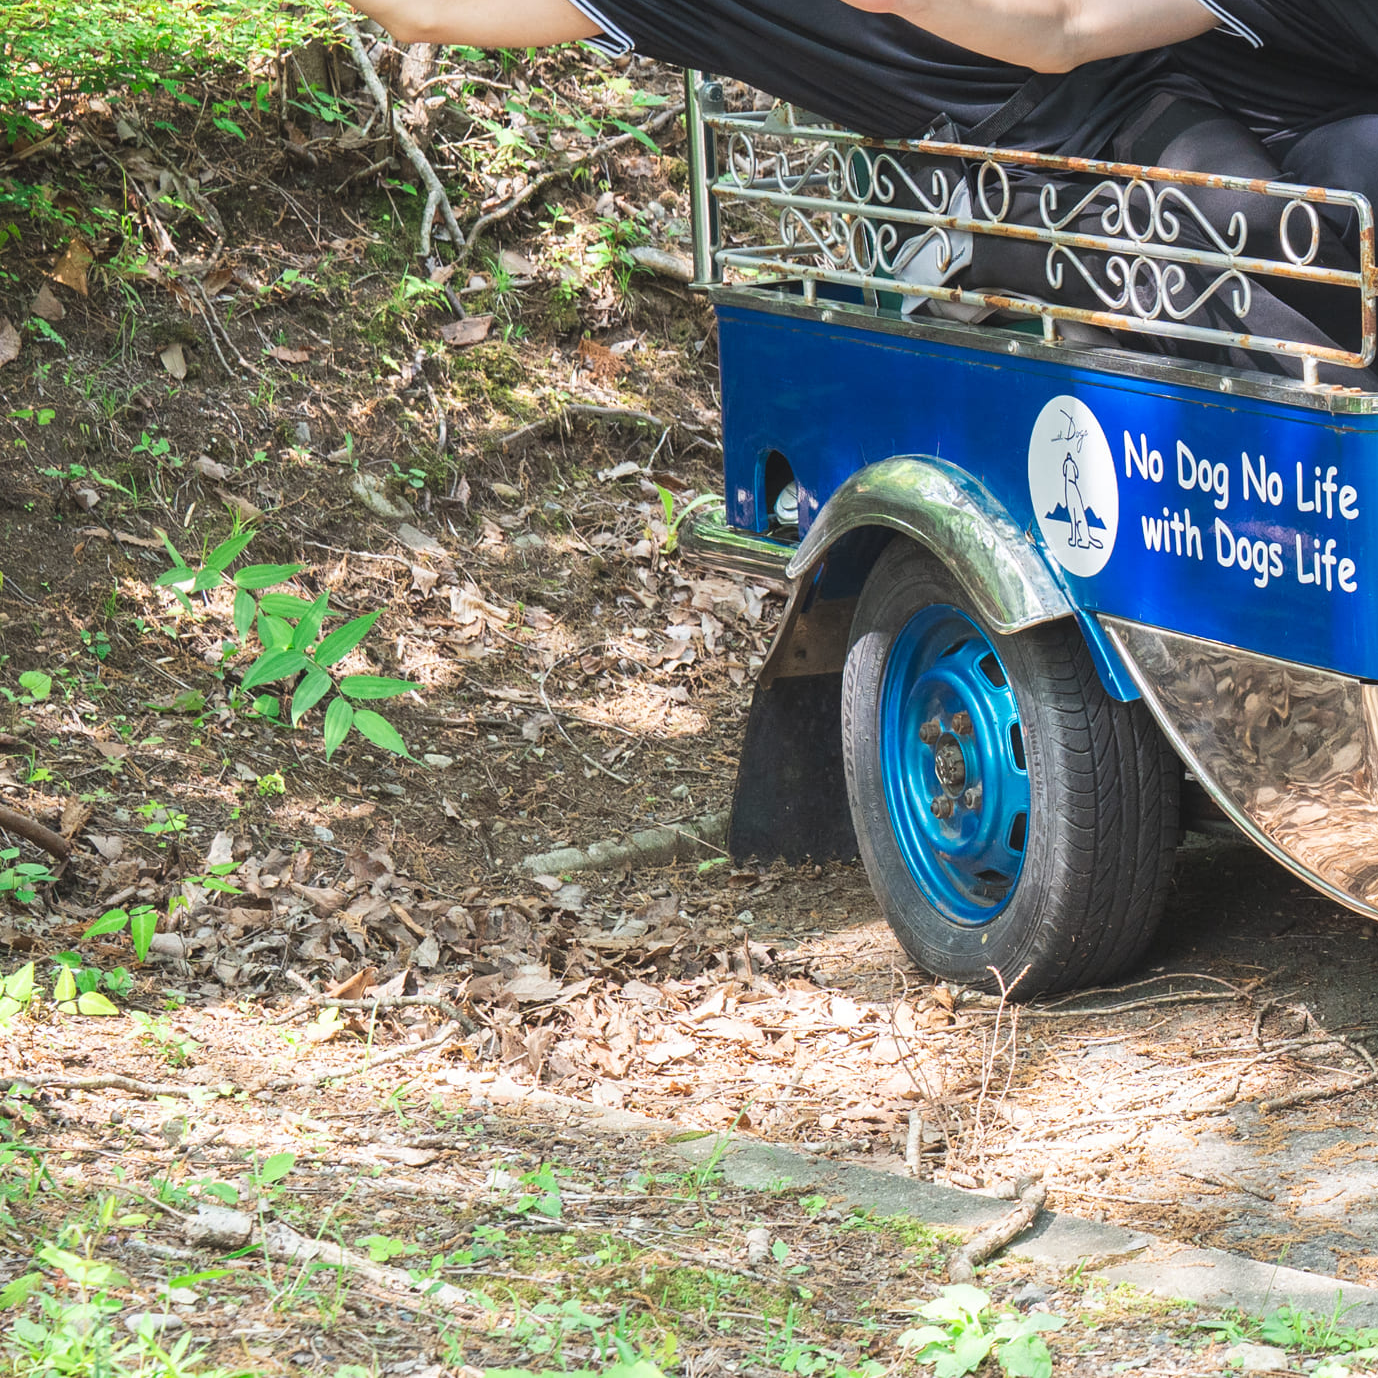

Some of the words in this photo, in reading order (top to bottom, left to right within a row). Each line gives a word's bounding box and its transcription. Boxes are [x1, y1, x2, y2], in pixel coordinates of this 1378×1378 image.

[1123, 429, 1164, 484] No
[1176, 439, 1230, 510] Dog
[1241, 451, 1284, 506] No
[1295, 461, 1360, 520] Life
[1141, 507, 1203, 561] with
[1214, 516, 1284, 589] Dogs
[1295, 533, 1358, 593] Life
[842, 648, 857, 781] DUNLOP
